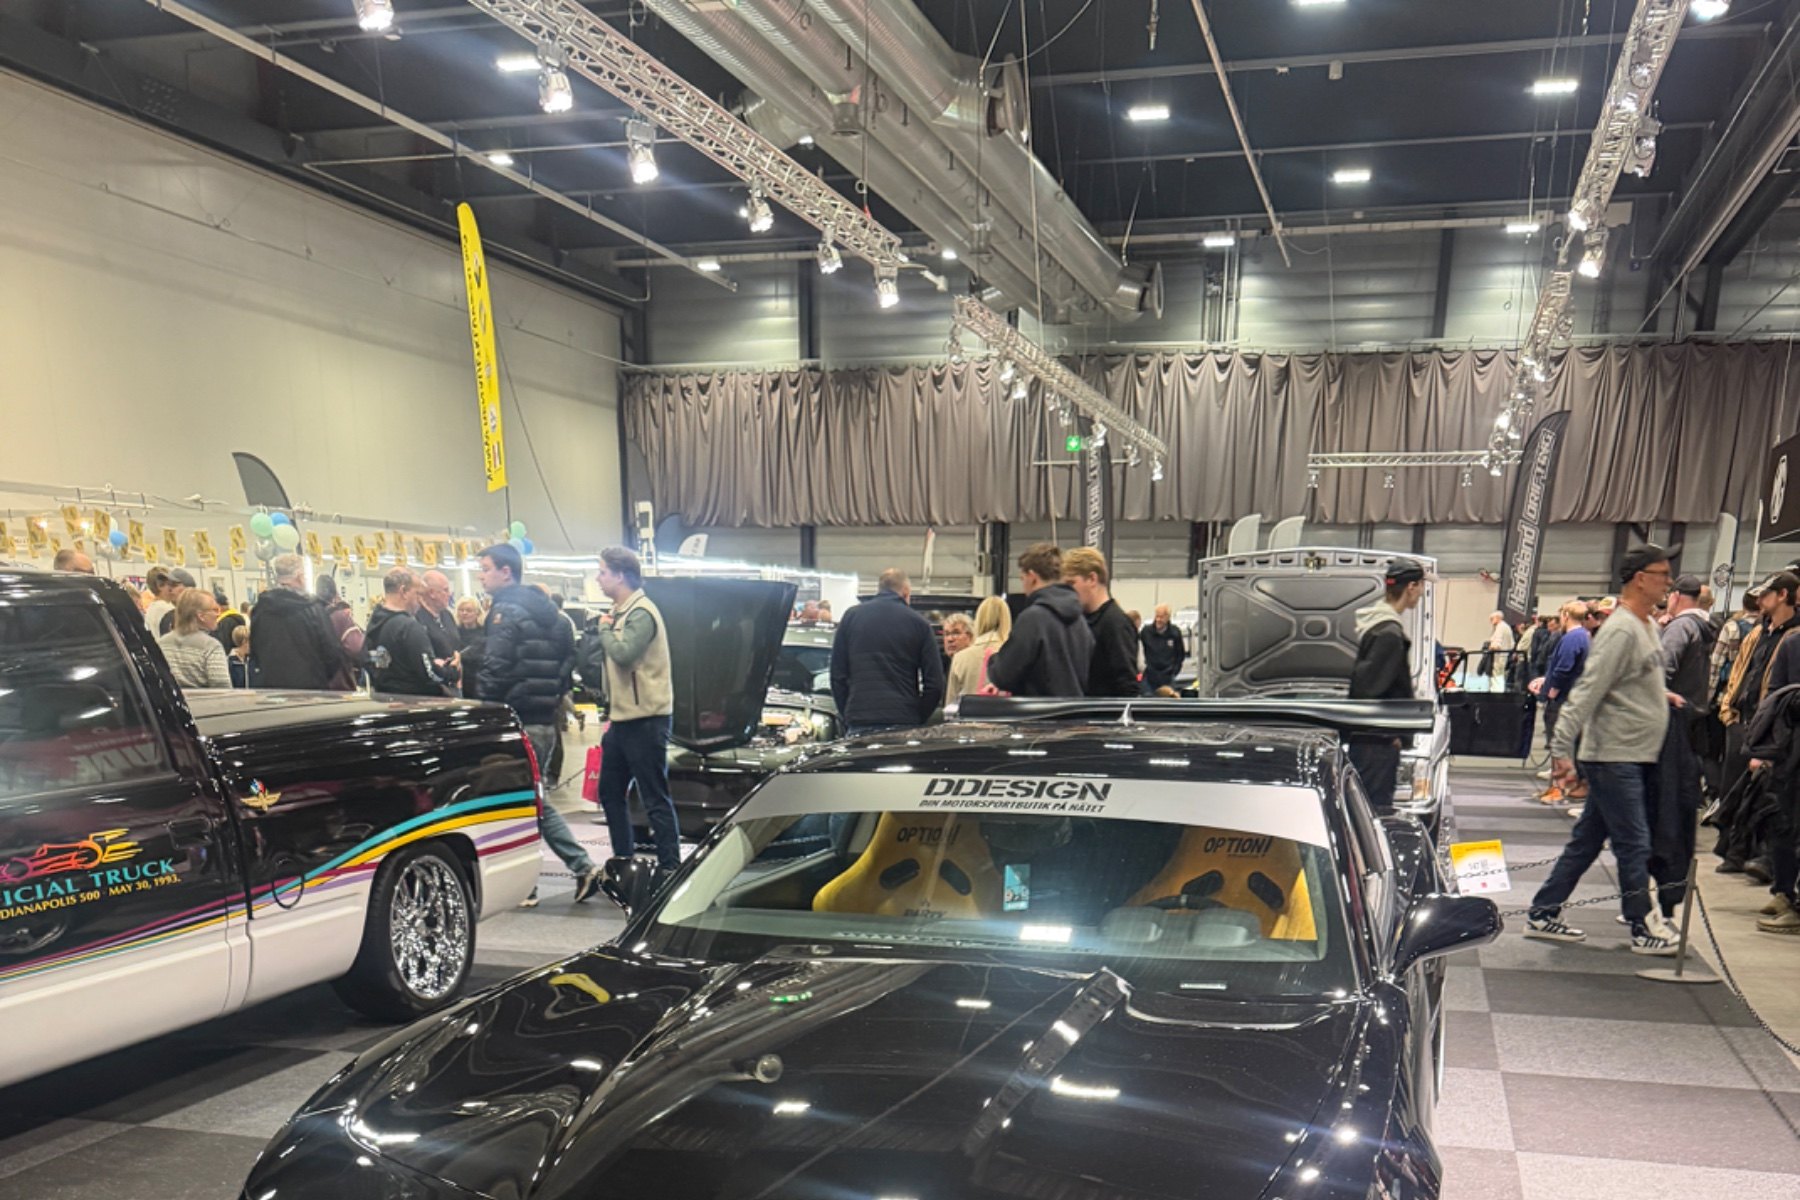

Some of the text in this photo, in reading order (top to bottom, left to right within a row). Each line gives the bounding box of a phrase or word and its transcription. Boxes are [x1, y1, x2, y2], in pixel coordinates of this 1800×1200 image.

[1507, 429, 1555, 614] Hadeland DRIFTING
[924, 778, 1112, 801] DDESIGN
[89, 858, 175, 889] TRUCK
[80, 890, 100, 904] 500
[109, 882, 133, 897] MAY
